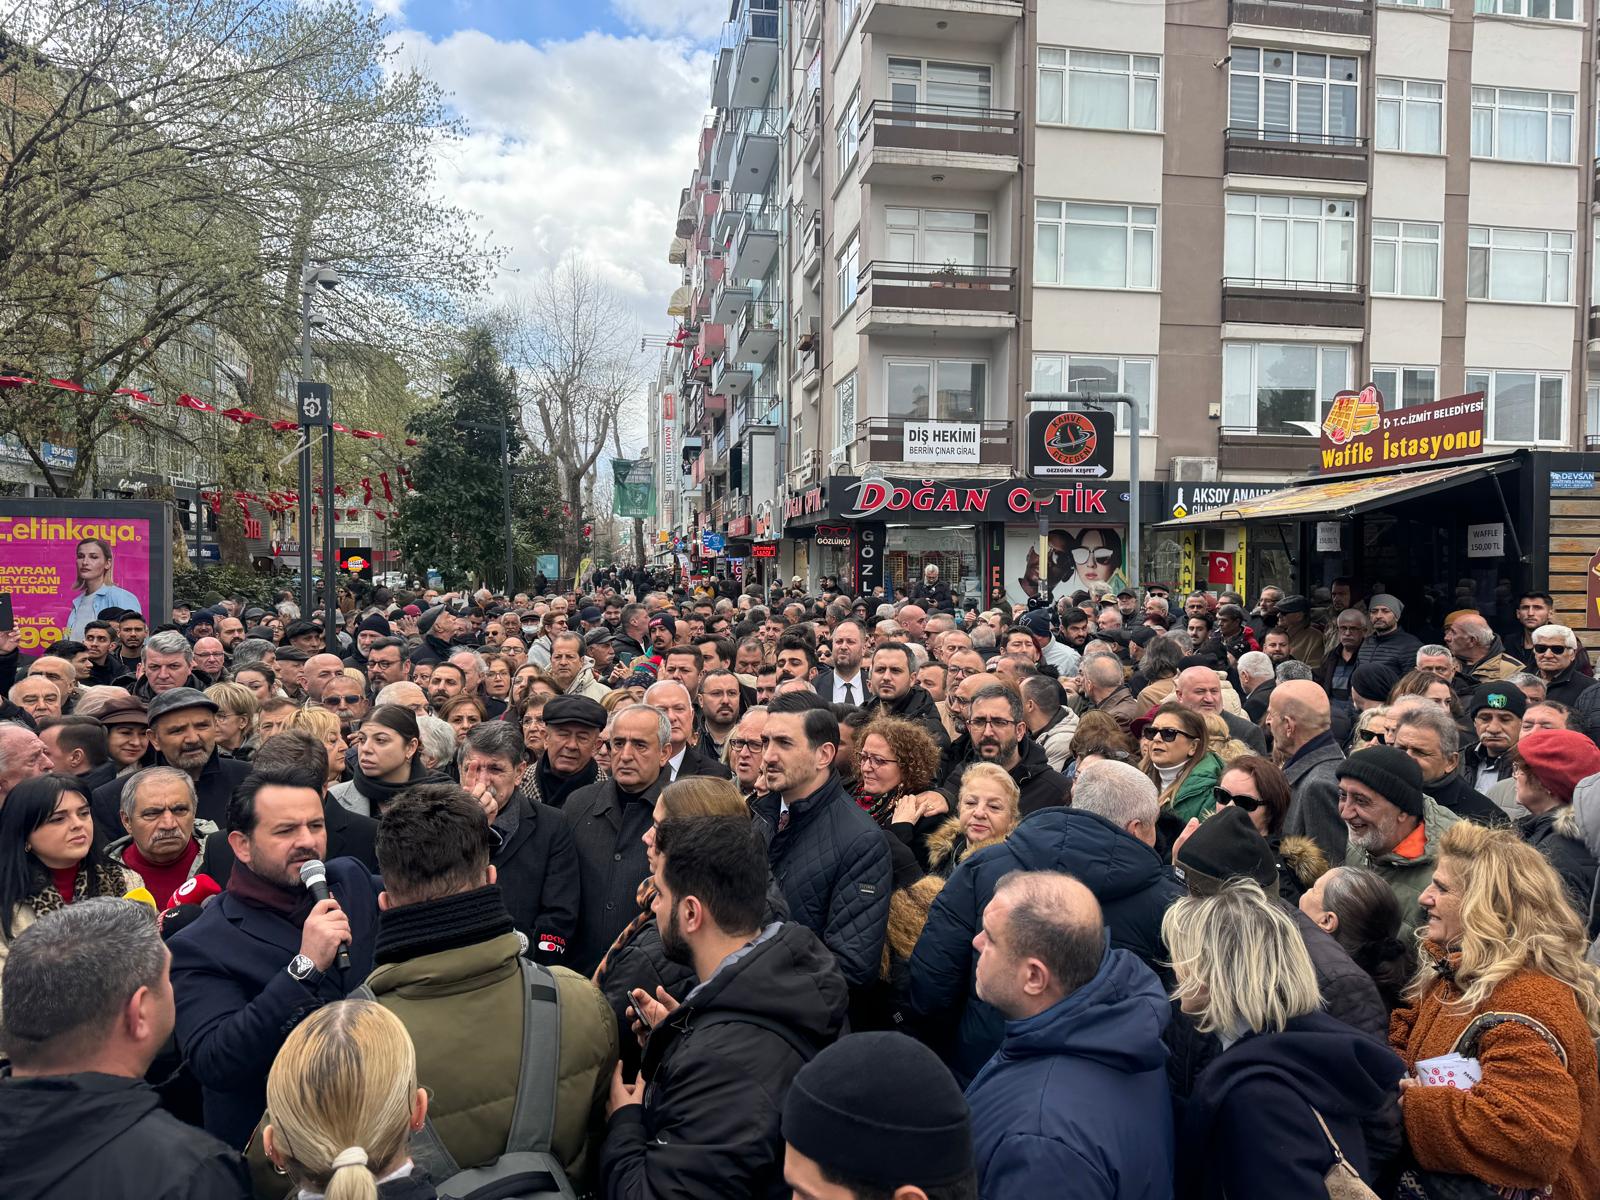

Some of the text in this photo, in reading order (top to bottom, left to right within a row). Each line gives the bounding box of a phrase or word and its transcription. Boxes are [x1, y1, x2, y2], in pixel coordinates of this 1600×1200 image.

[1433, 398, 1484, 419] BELEDİYESİ
[1052, 414, 1082, 428] KAHVE
[909, 427, 976, 445] DİŞ HEKİMİ
[909, 445, 976, 456] BERRİN ÇINAR GİRAL
[1322, 429, 1481, 469] Waffle İstasyonu
[1561, 472, 1594, 480] DEVSAN
[841, 479, 991, 518] DOĞAN
[1192, 488, 1231, 503] AKSOY
[1472, 530, 1498, 538] WAFFLE
[861, 530, 874, 598] GÖZL
[1183, 536, 1192, 595] ANAH
